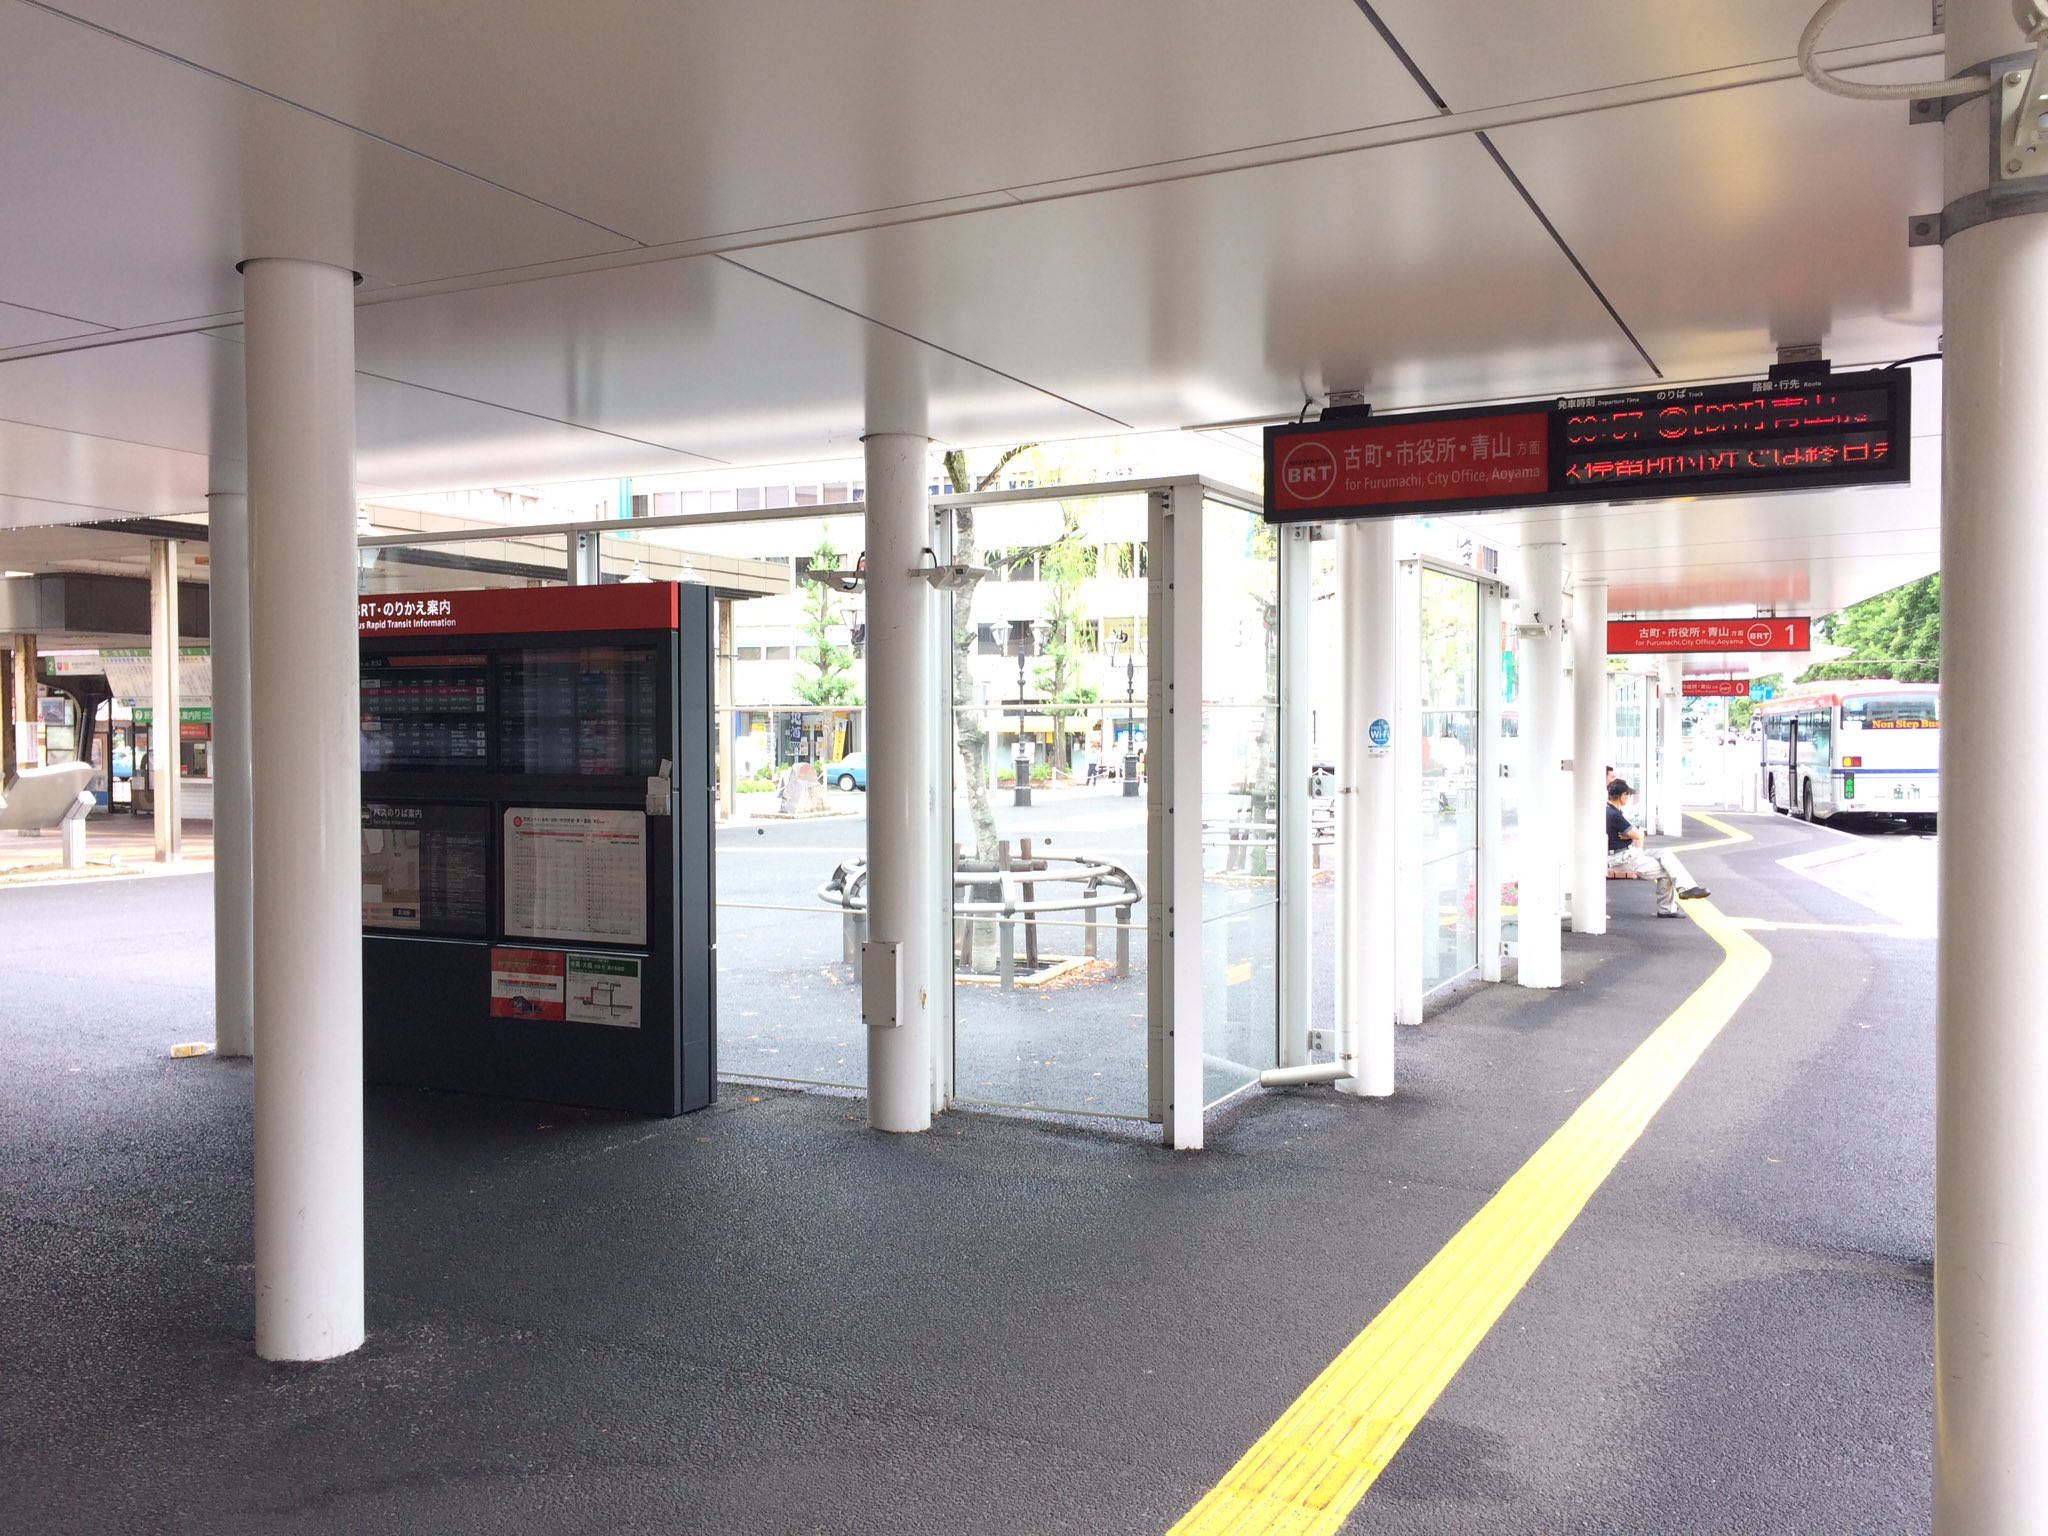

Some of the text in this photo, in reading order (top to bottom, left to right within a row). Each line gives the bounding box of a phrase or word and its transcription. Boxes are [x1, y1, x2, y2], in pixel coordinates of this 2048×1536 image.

[1752, 380, 1800, 392] 路線・行先
[1656, 389, 1687, 400] のりば
[1557, 398, 1596, 410] 発車時刻
[1597, 399, 1625, 407] Departure
[1343, 432, 1540, 471] 古町・市役所・青山 方面
[1288, 465, 1332, 484] BRT
[1345, 467, 1540, 490] for Furumachi, City Office, Aoyama
[366, 620, 386, 631] Rapid
[387, 619, 412, 628] Transit
[413, 618, 456, 628] Information
[1639, 627, 1744, 639] 古町・市役所・青山 方面
[1785, 624, 1794, 646] 1
[48, 663, 54, 671] 2
[1735, 683, 1744, 694] 0
[1872, 719, 1941, 730] Non Step Bus
[373, 808, 423, 819] バスのりば案内
